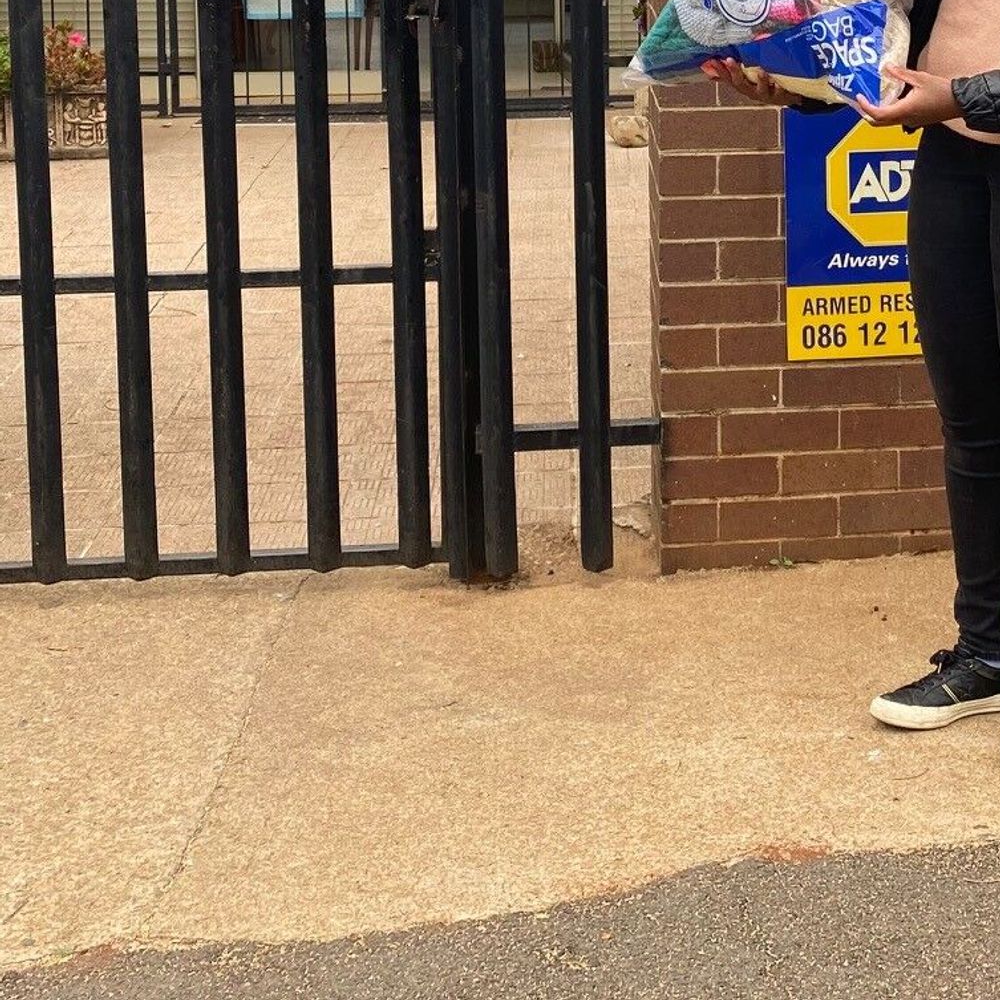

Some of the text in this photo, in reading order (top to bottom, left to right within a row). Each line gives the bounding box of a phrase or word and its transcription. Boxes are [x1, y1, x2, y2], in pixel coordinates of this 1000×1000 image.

[811, 15, 854, 41] BAG
[811, 36, 878, 69] SPACE
[827, 252, 899, 270] Always
[802, 295, 872, 316] ARMED
[801, 323, 847, 350] 086
[858, 321, 887, 347] 12
